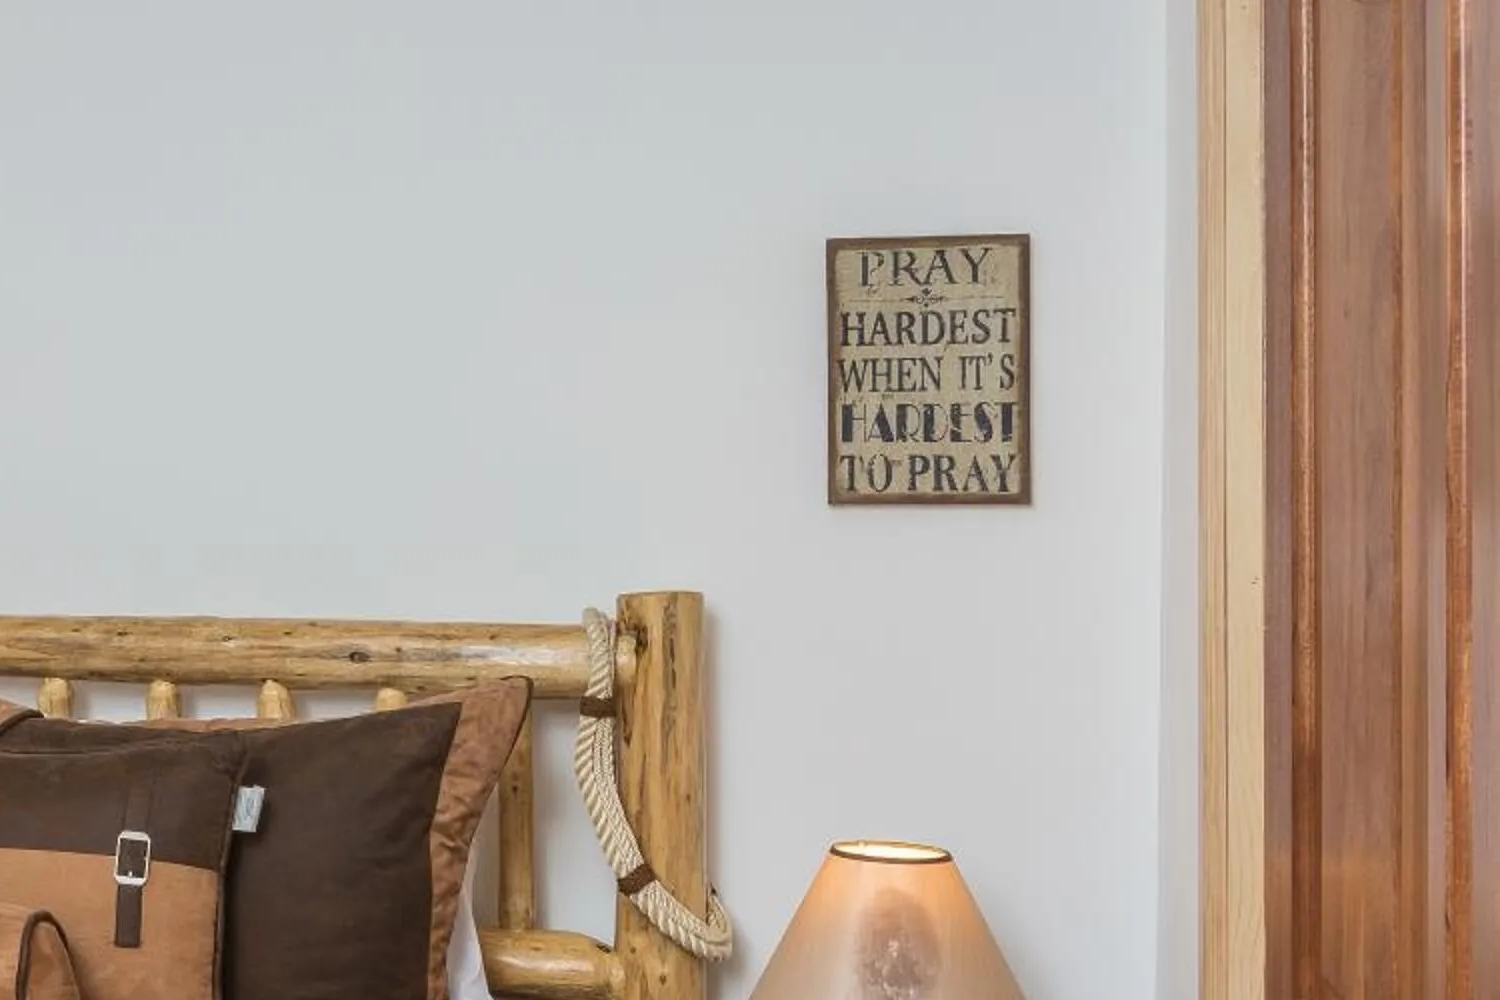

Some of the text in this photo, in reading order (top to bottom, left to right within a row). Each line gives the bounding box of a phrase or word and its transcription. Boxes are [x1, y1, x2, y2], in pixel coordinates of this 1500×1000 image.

[858, 248, 992, 287] PRAY
[840, 308, 1016, 346] HARDEST
[838, 353, 1015, 393] WHEN IT'S
[841, 402, 1018, 443] HARDEST
[840, 454, 1016, 493] TO PRAY
